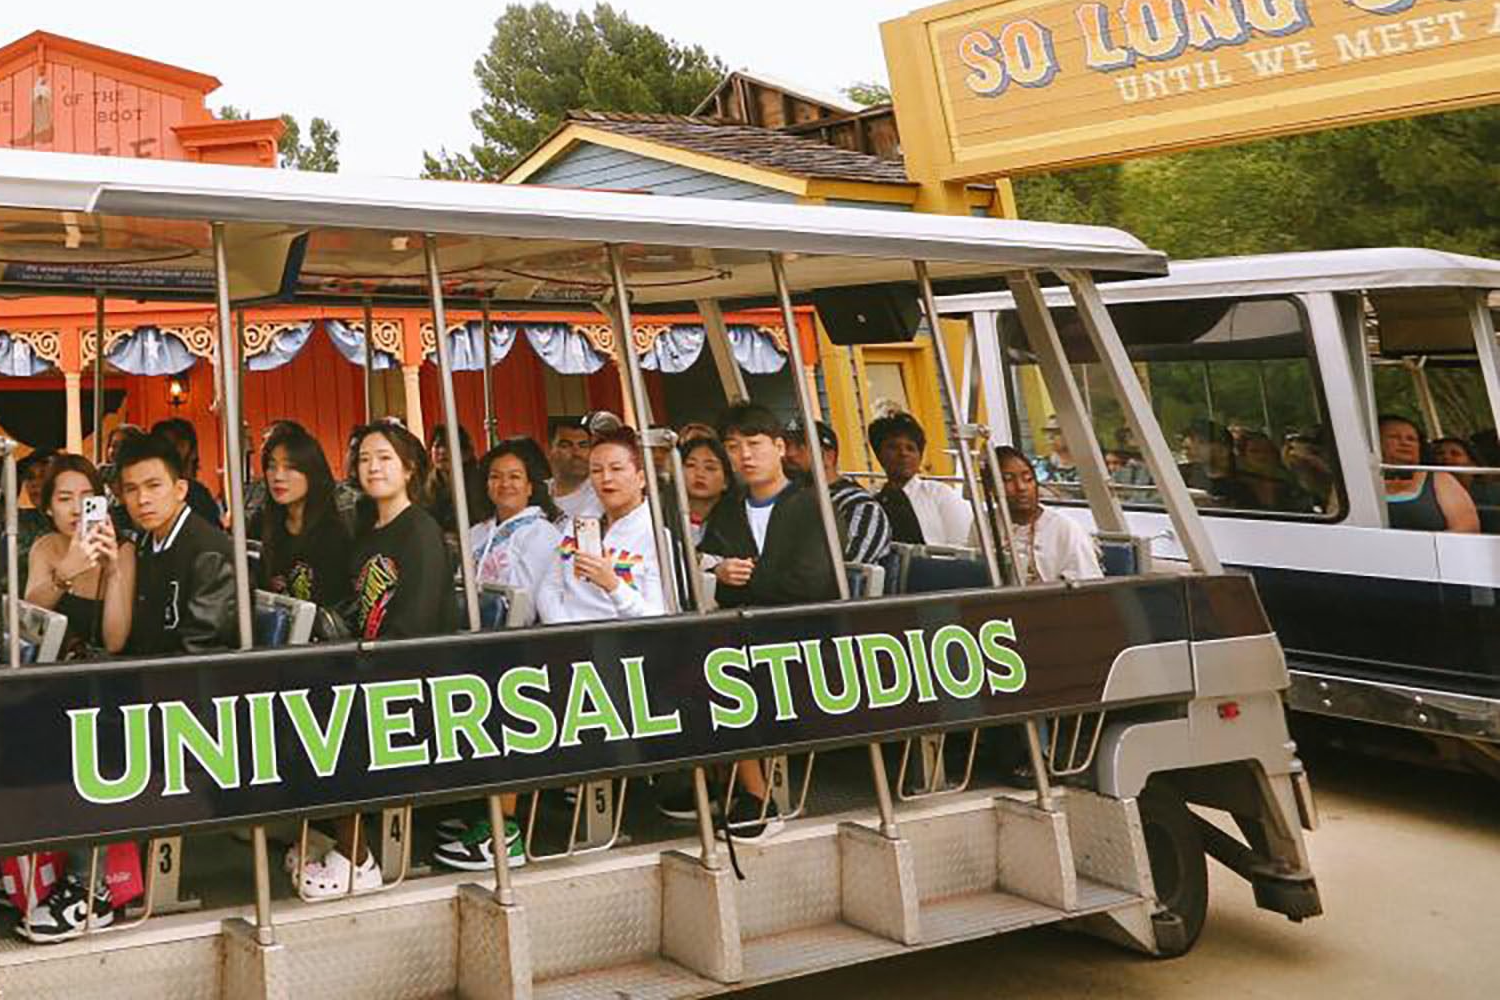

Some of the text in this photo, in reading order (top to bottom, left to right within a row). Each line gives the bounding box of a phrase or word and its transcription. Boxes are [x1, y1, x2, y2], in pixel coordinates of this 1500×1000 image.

[957, 17, 1060, 97] SO
[1115, 61, 1233, 103] UNTIL
[1243, 44, 1317, 78] WE
[1334, 10, 1466, 63] MEET
[62, 92, 85, 107] OF
[66, 620, 1028, 805] UNIVERSAL STUDIOS
[595, 788, 606, 814] 5
[388, 819, 401, 844] 4
[160, 843, 172, 875] 3
